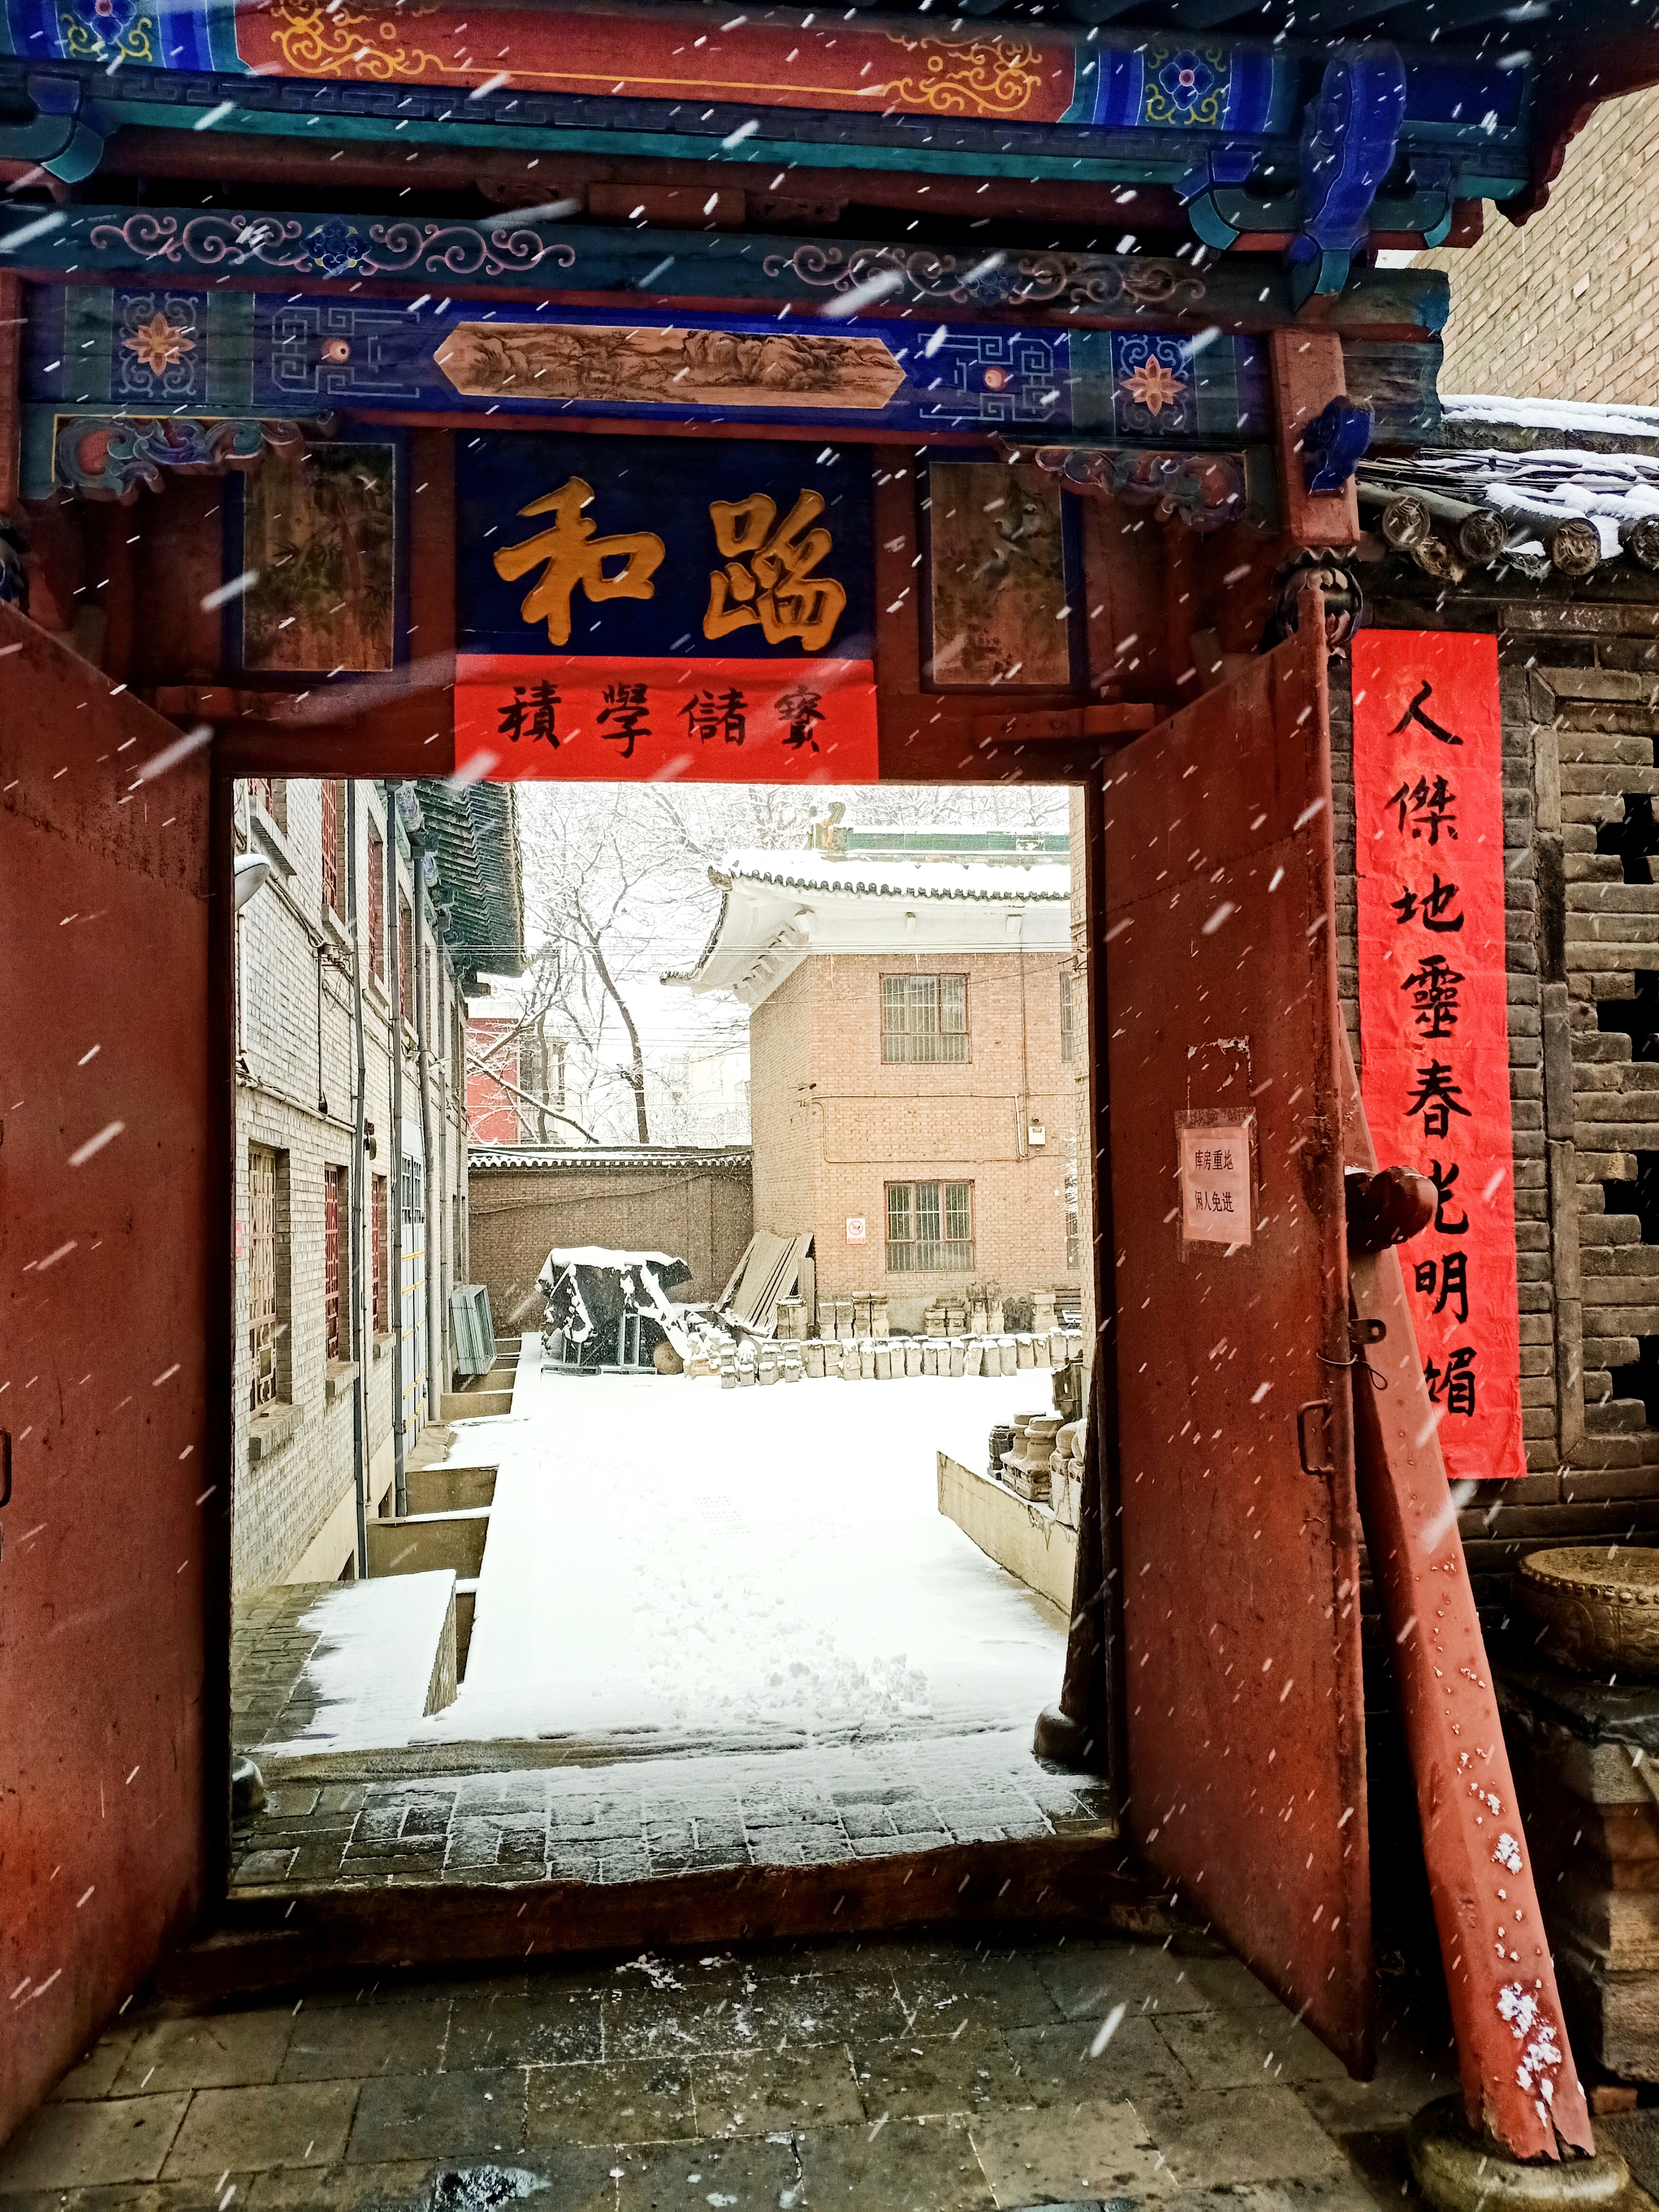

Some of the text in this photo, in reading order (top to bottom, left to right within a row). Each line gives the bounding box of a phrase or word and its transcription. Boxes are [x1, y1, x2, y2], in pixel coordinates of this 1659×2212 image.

[1195, 1149, 1233, 1170] 库房重地
[1195, 1190, 1234, 1212] 闲人免进
